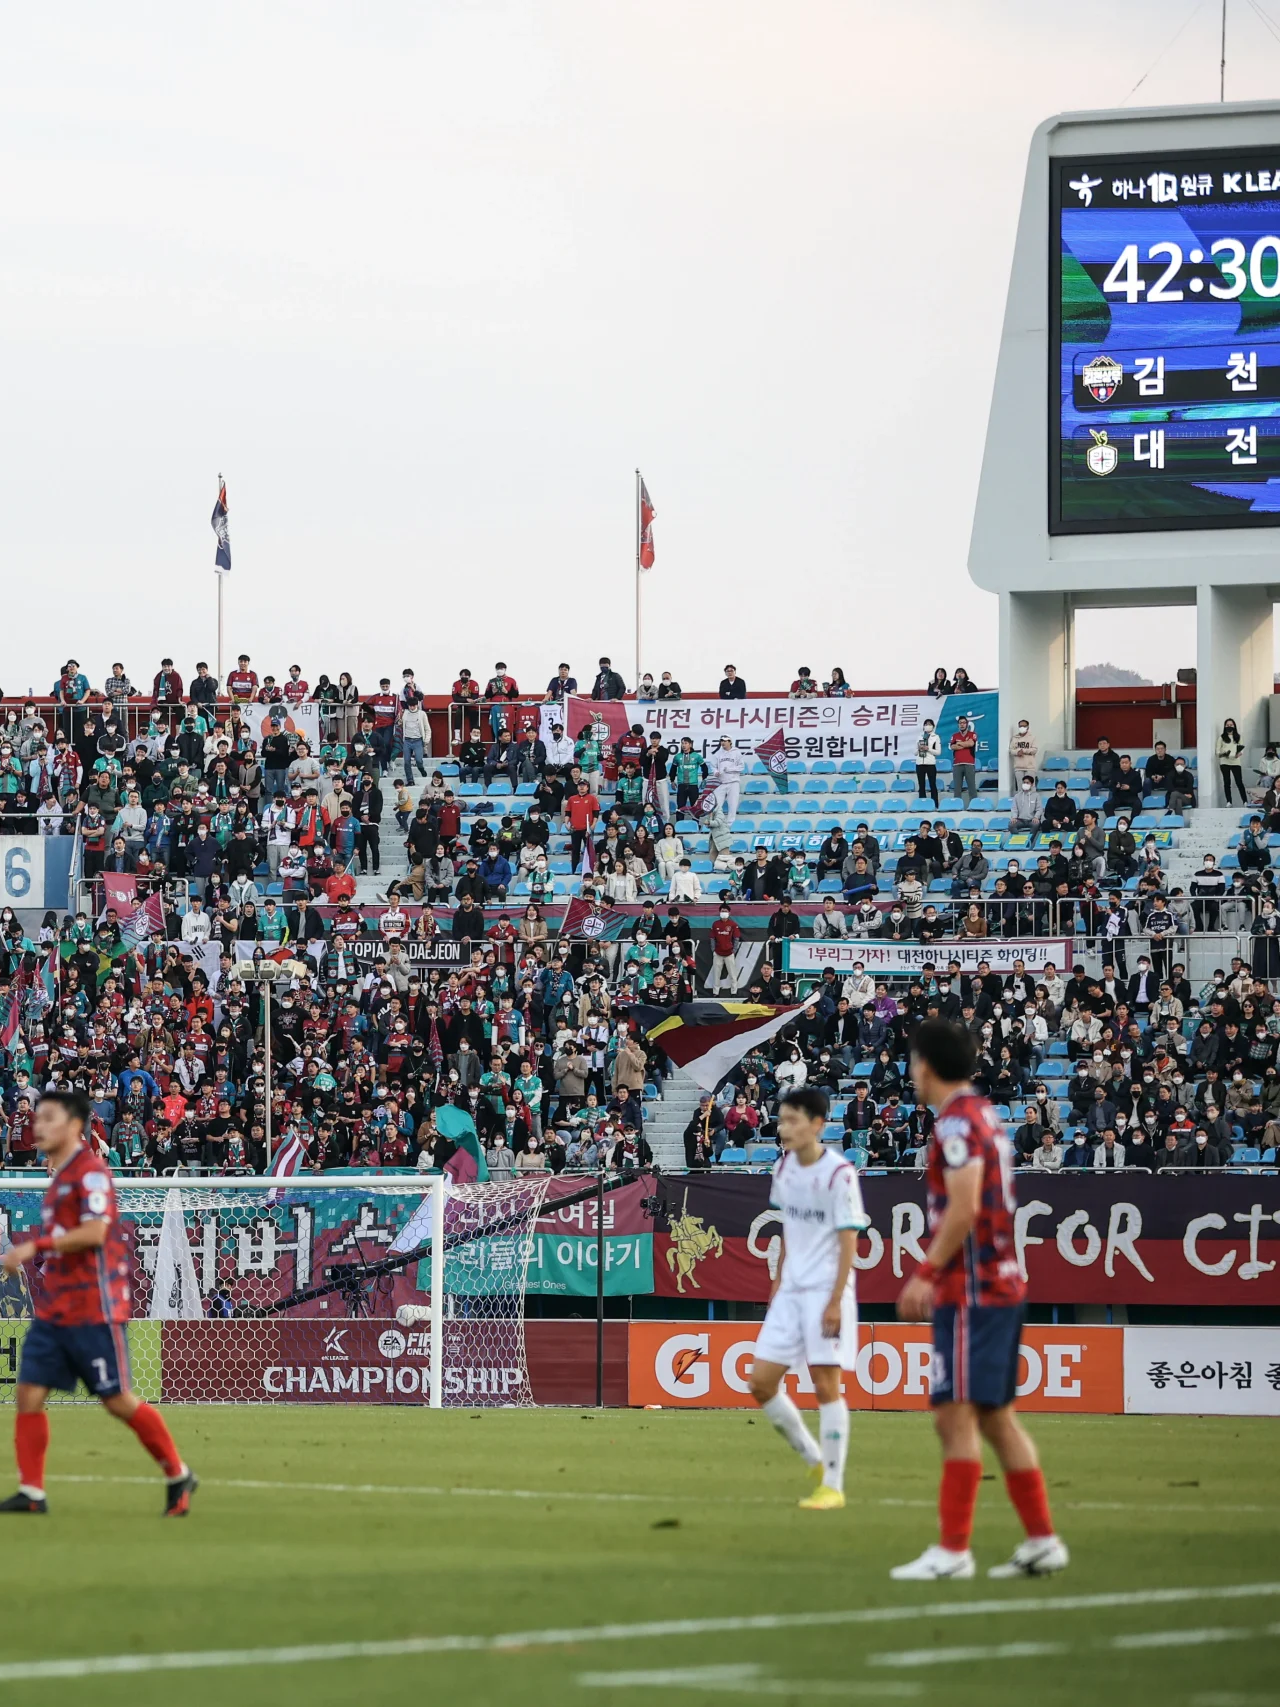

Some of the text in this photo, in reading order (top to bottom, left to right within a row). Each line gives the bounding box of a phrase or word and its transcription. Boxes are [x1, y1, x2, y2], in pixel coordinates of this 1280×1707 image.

[1103, 235, 1280, 303] 42:30
[646, 704, 920, 730] 대전 하나시티즌의 승리를
[5, 847, 31, 897] 6
[808, 947, 1047, 964] 1부리그 가자! 대전하나시티즌 화이팅!!
[557, 1238, 641, 1272] 이야기
[1014, 1200, 1154, 1283] FOR
[1183, 1204, 1280, 1281] CI
[1146, 1361, 1252, 1390] 좋은아침
